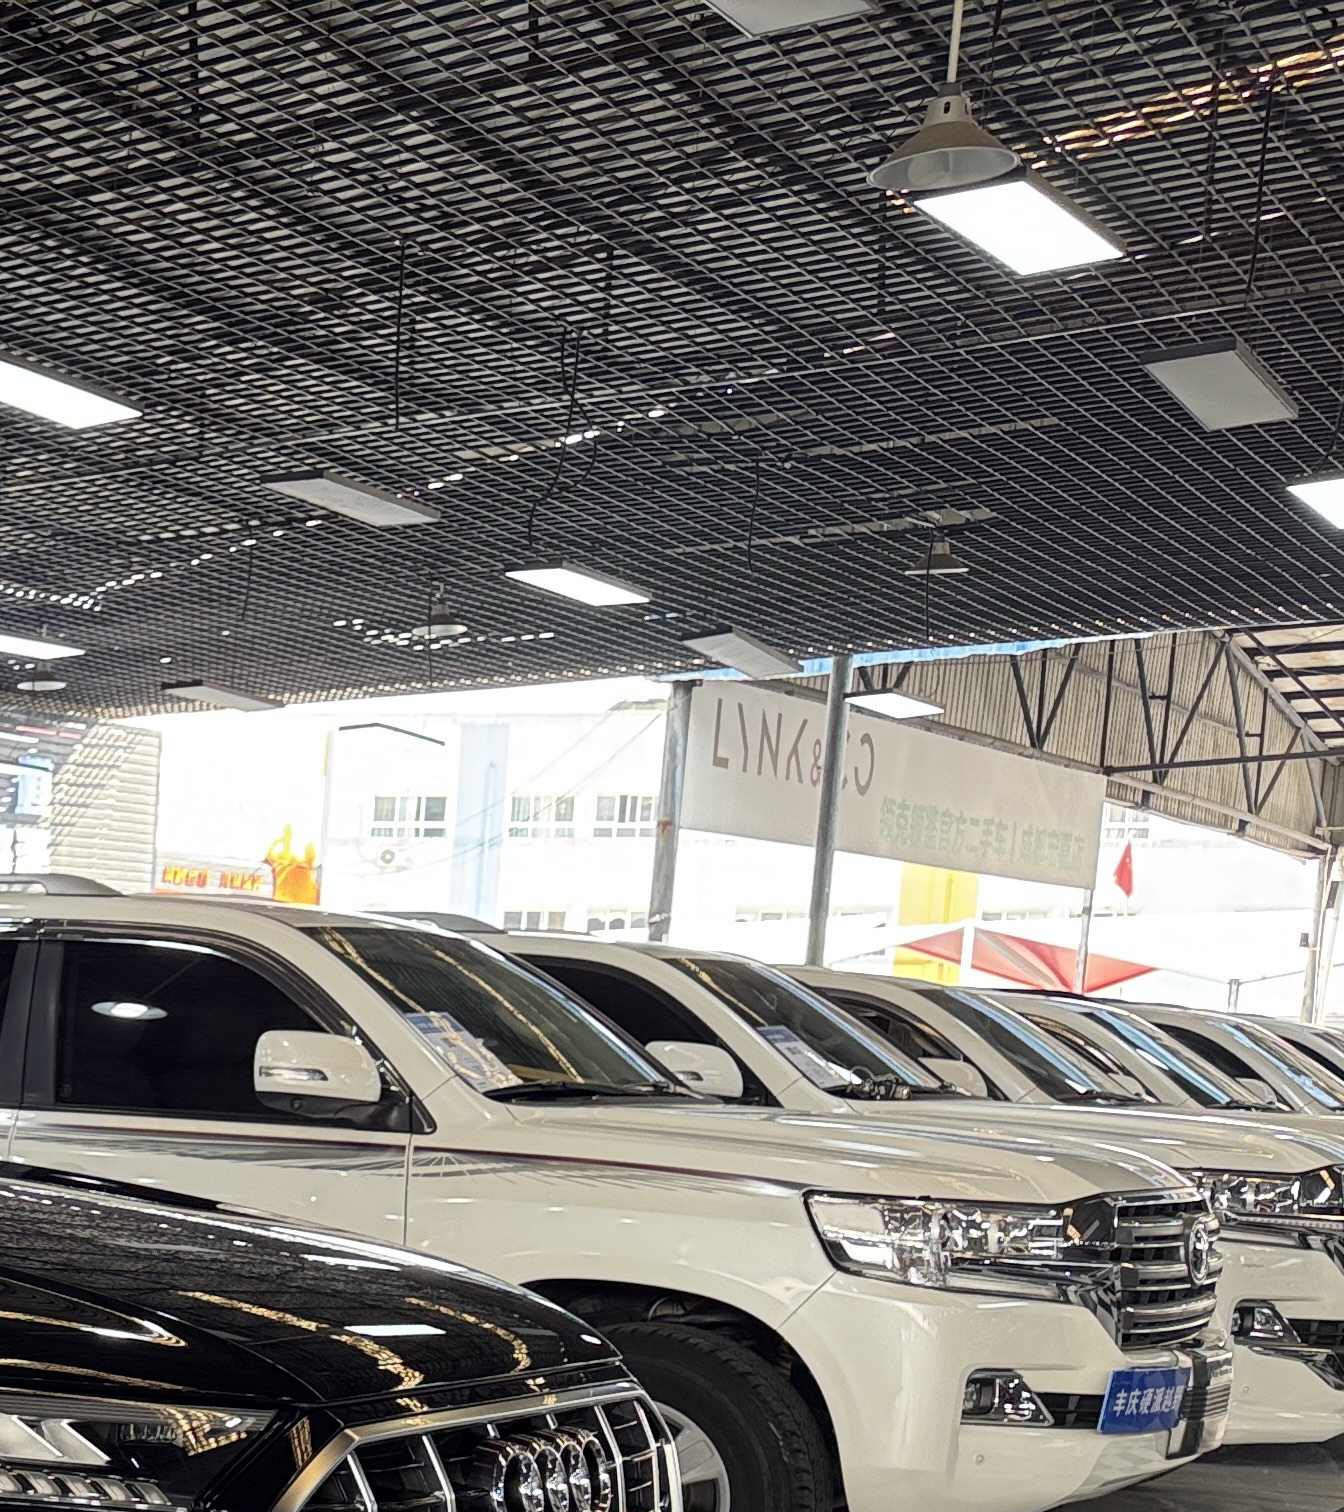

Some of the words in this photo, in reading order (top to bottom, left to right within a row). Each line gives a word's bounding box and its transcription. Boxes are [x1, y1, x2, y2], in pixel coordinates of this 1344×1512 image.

[712, 697, 875, 797] LYNK&O
[1113, 1384, 1185, 1418] 丰庆硬派越野
